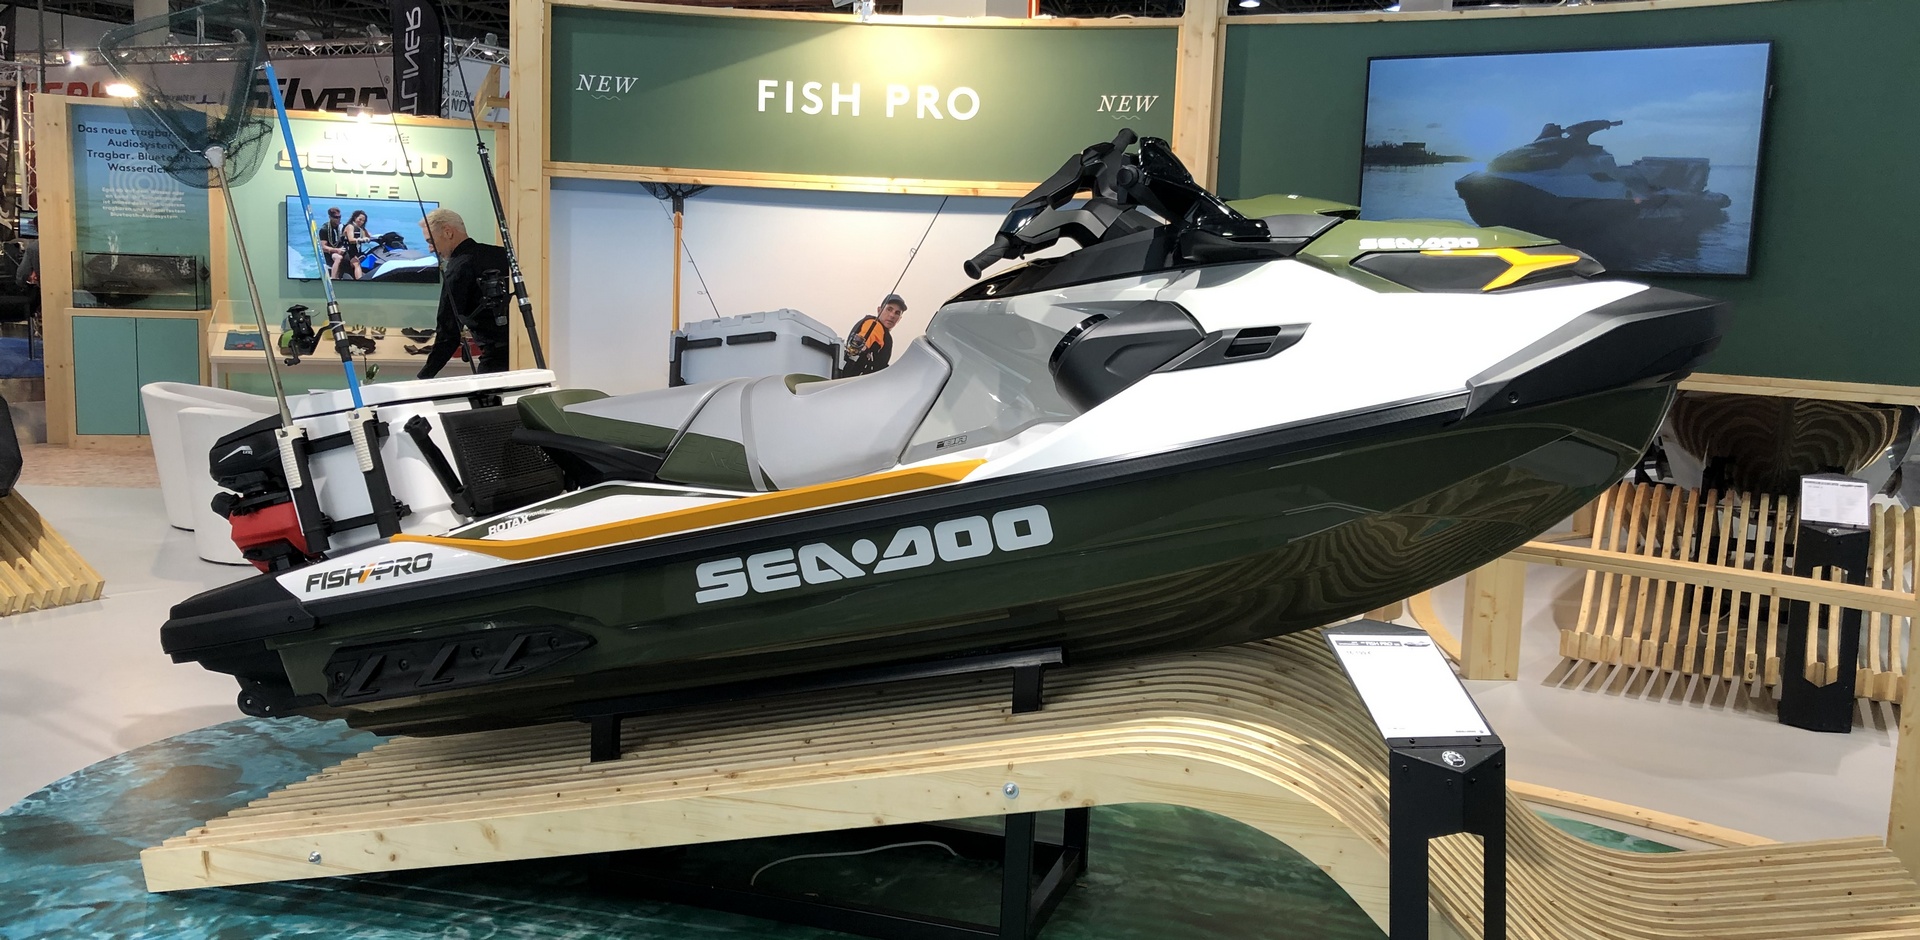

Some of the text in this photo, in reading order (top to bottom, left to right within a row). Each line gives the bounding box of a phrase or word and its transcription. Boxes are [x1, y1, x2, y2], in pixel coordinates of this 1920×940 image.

[575, 73, 639, 94] NEW
[757, 79, 981, 121] FISH PRO
[1096, 95, 1160, 113] NEW
[77, 124, 176, 138] Das neue tragbar
[87, 149, 135, 161] Tragbar.
